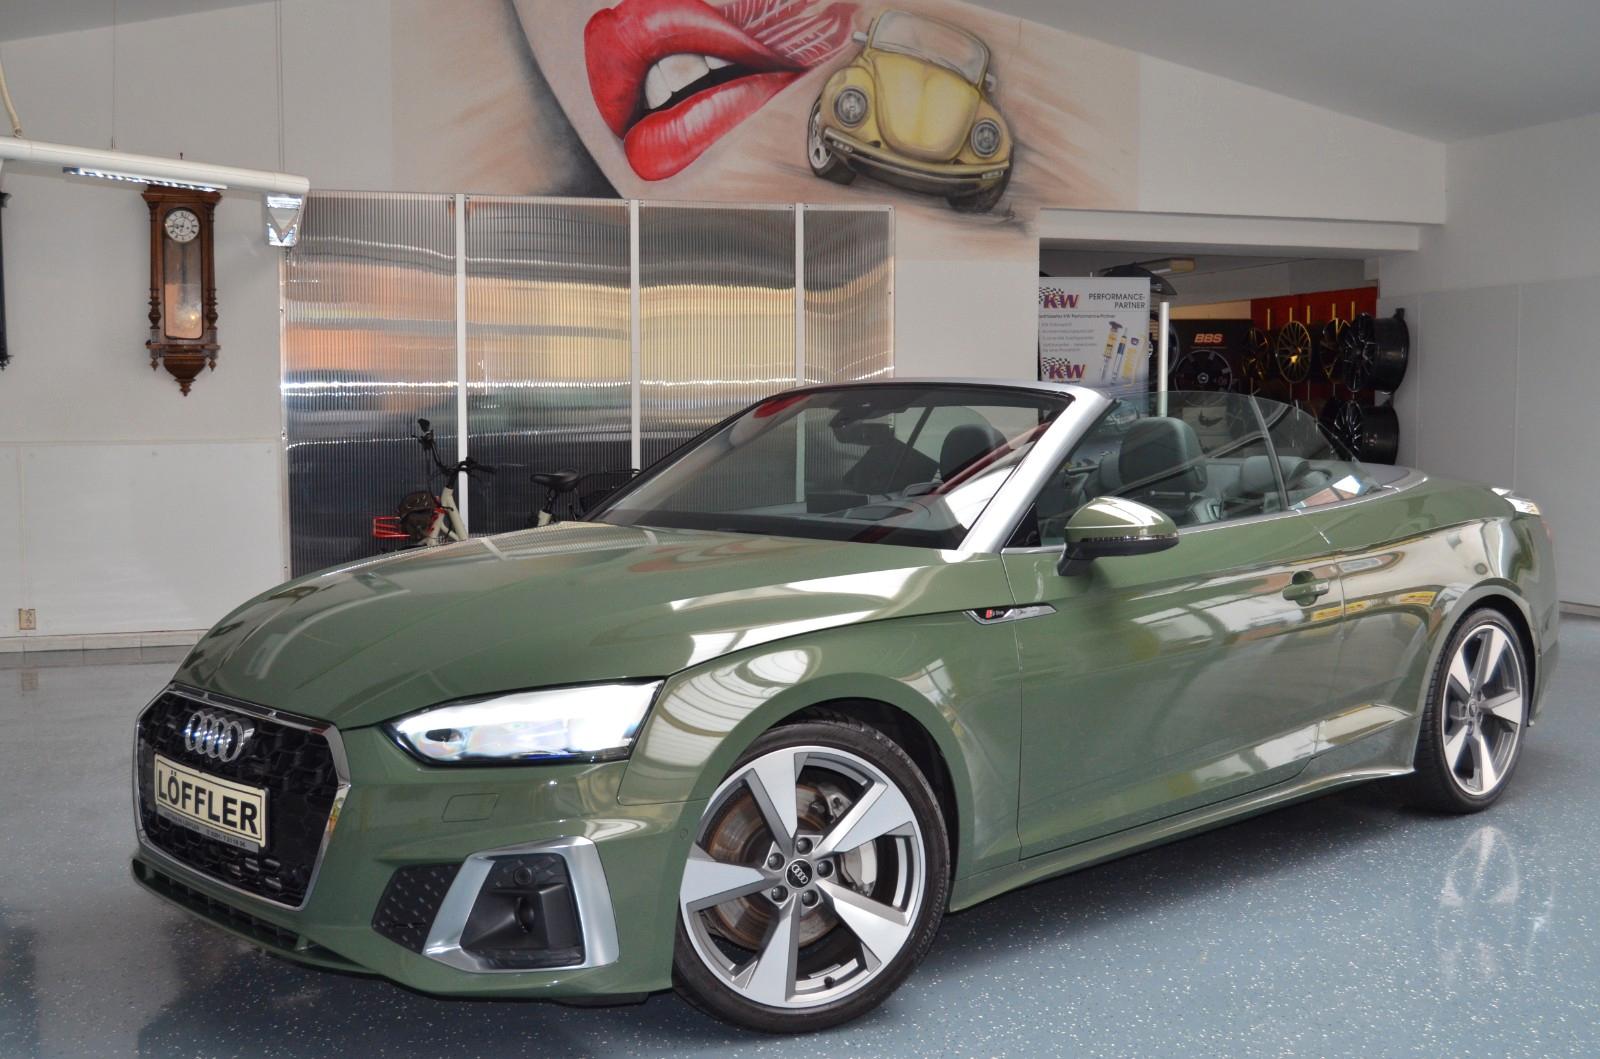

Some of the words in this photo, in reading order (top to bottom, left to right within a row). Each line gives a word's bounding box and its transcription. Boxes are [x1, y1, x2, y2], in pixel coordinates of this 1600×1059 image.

[1043, 293, 1079, 309] KW
[1114, 301, 1146, 309] PARTNER
[1194, 333, 1223, 343] BBS
[1049, 363, 1086, 379] KW
[158, 769, 259, 836] LÖFFLER
